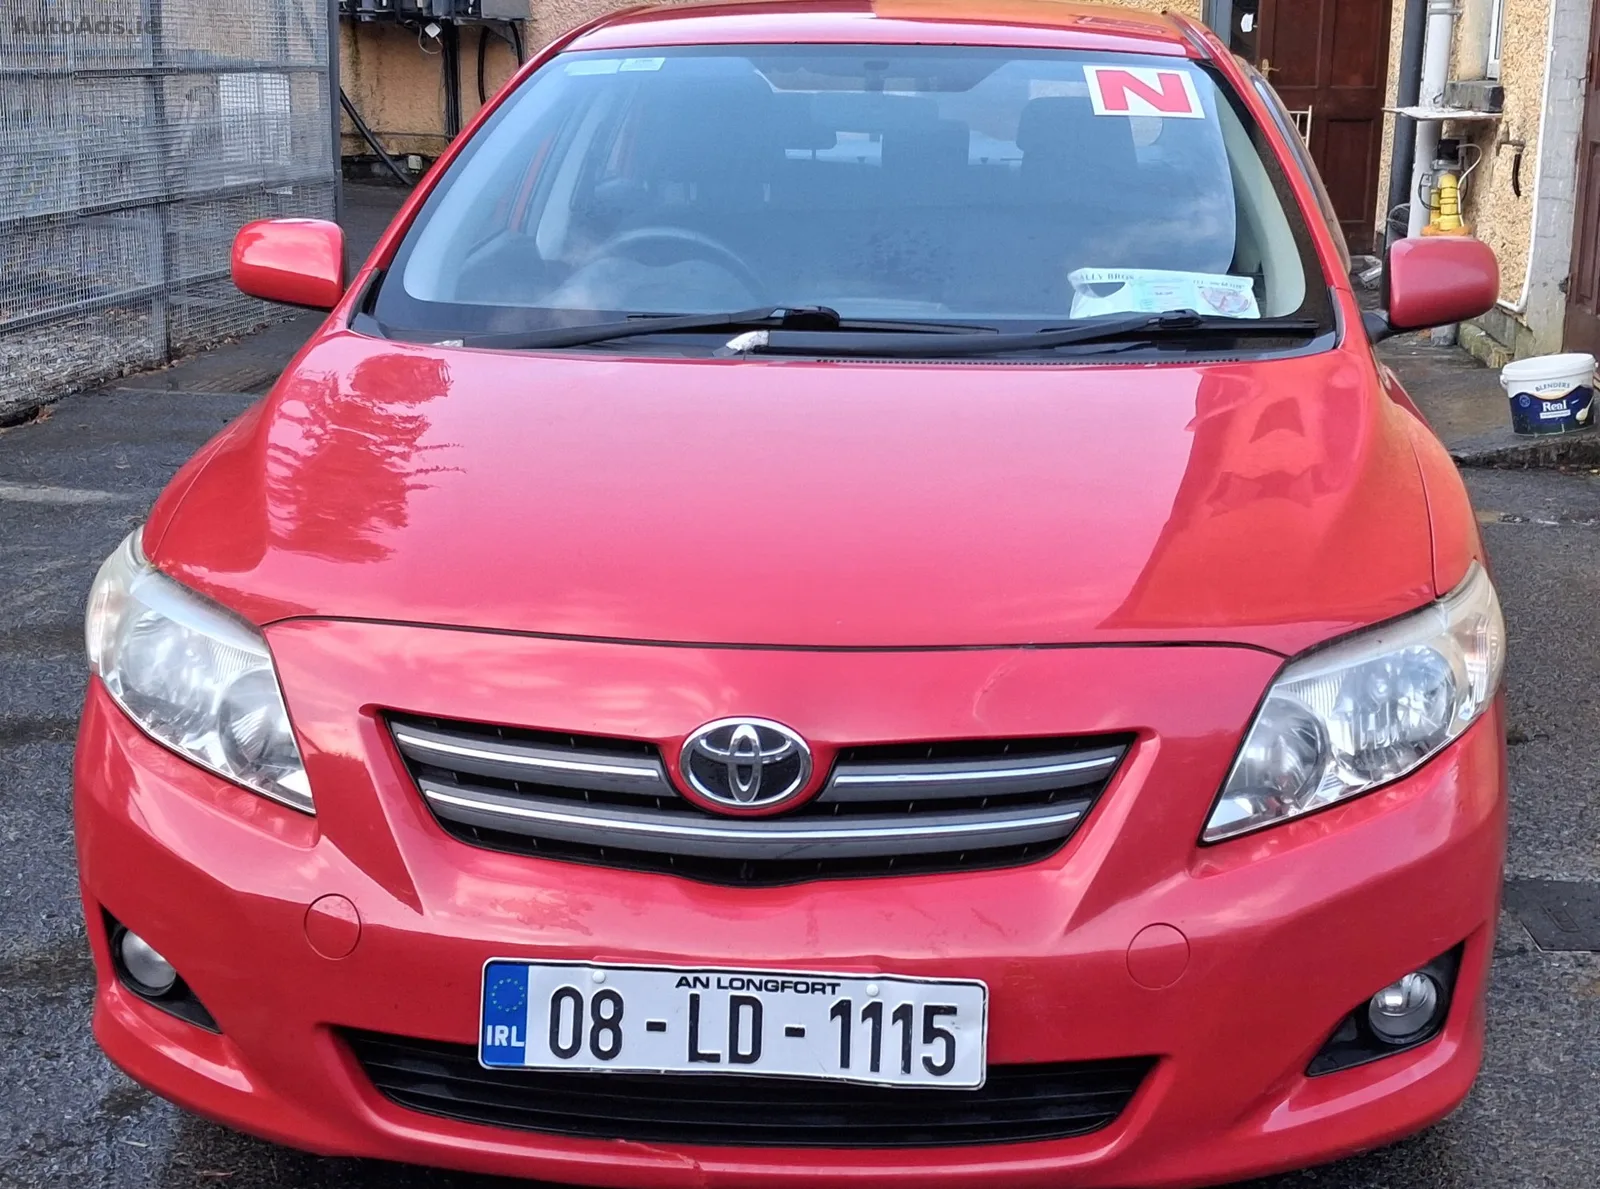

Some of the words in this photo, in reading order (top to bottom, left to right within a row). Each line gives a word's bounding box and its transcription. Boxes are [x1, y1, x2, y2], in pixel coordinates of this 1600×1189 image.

[1095, 70, 1192, 113] N
[1535, 382, 1570, 391] BLENDERS
[1542, 399, 1567, 411] Real
[675, 975, 710, 990] AN
[717, 976, 841, 996] LONGFORT
[486, 1024, 525, 1048] IRL
